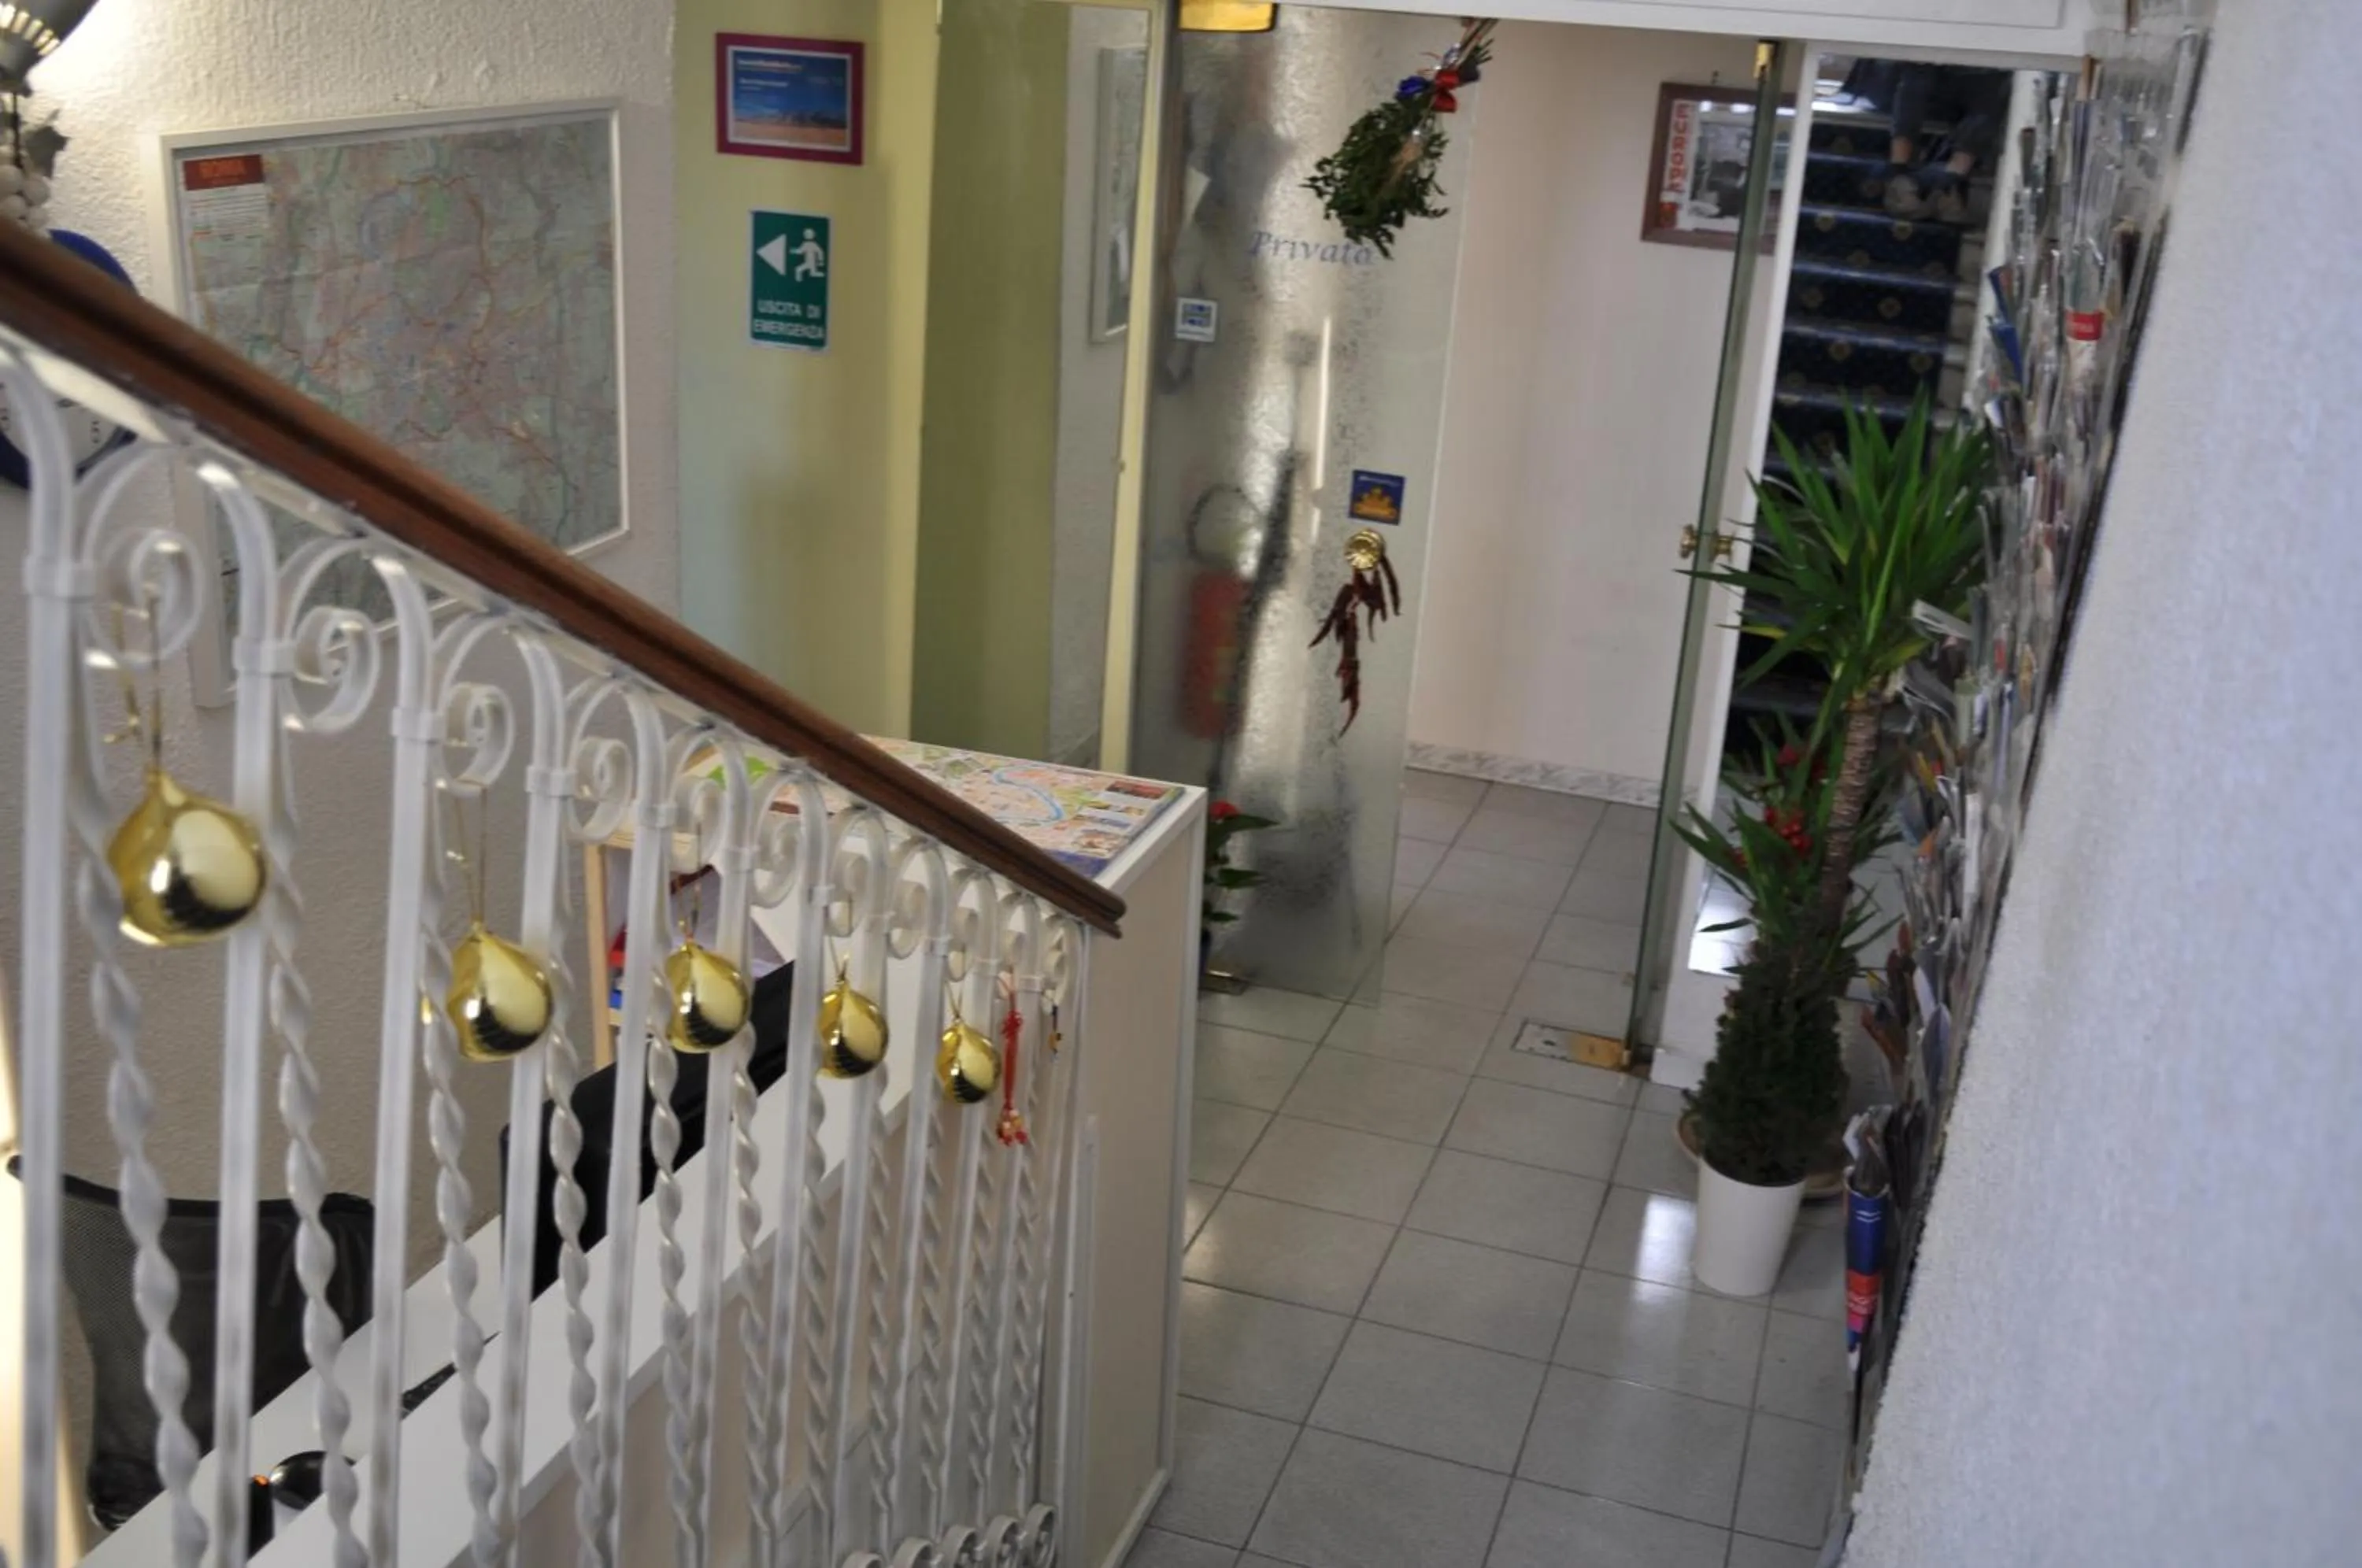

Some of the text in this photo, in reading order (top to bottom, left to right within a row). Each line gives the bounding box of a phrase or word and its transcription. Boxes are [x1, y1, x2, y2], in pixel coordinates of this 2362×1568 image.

[757, 299, 821, 319] USCITA DI
[754, 318, 824, 339] EMERGENZA
